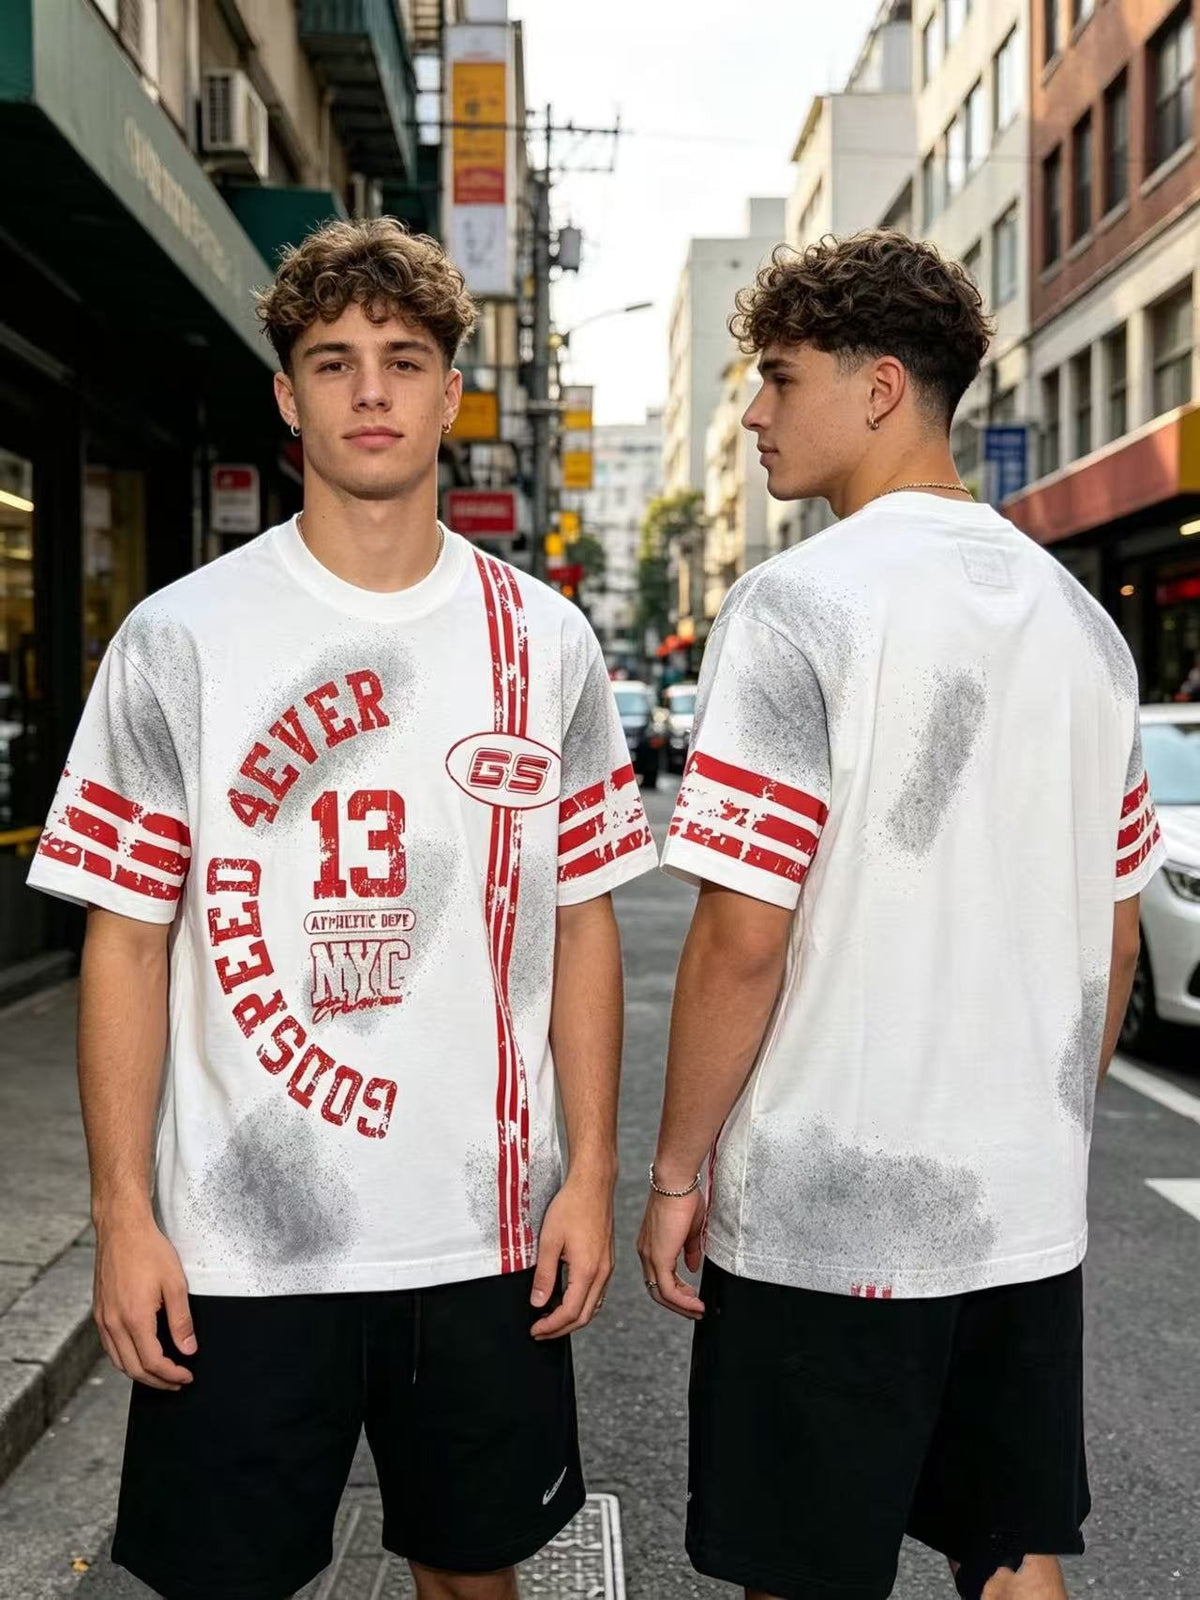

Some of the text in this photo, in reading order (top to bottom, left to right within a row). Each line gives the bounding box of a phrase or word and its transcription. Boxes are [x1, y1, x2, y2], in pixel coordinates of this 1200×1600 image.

[227, 669, 390, 828] 4EVER
[467, 747, 552, 796] GS
[311, 789, 407, 899] 13
[206, 857, 398, 1139] GODSPEED
[310, 938, 411, 1007] NYC
